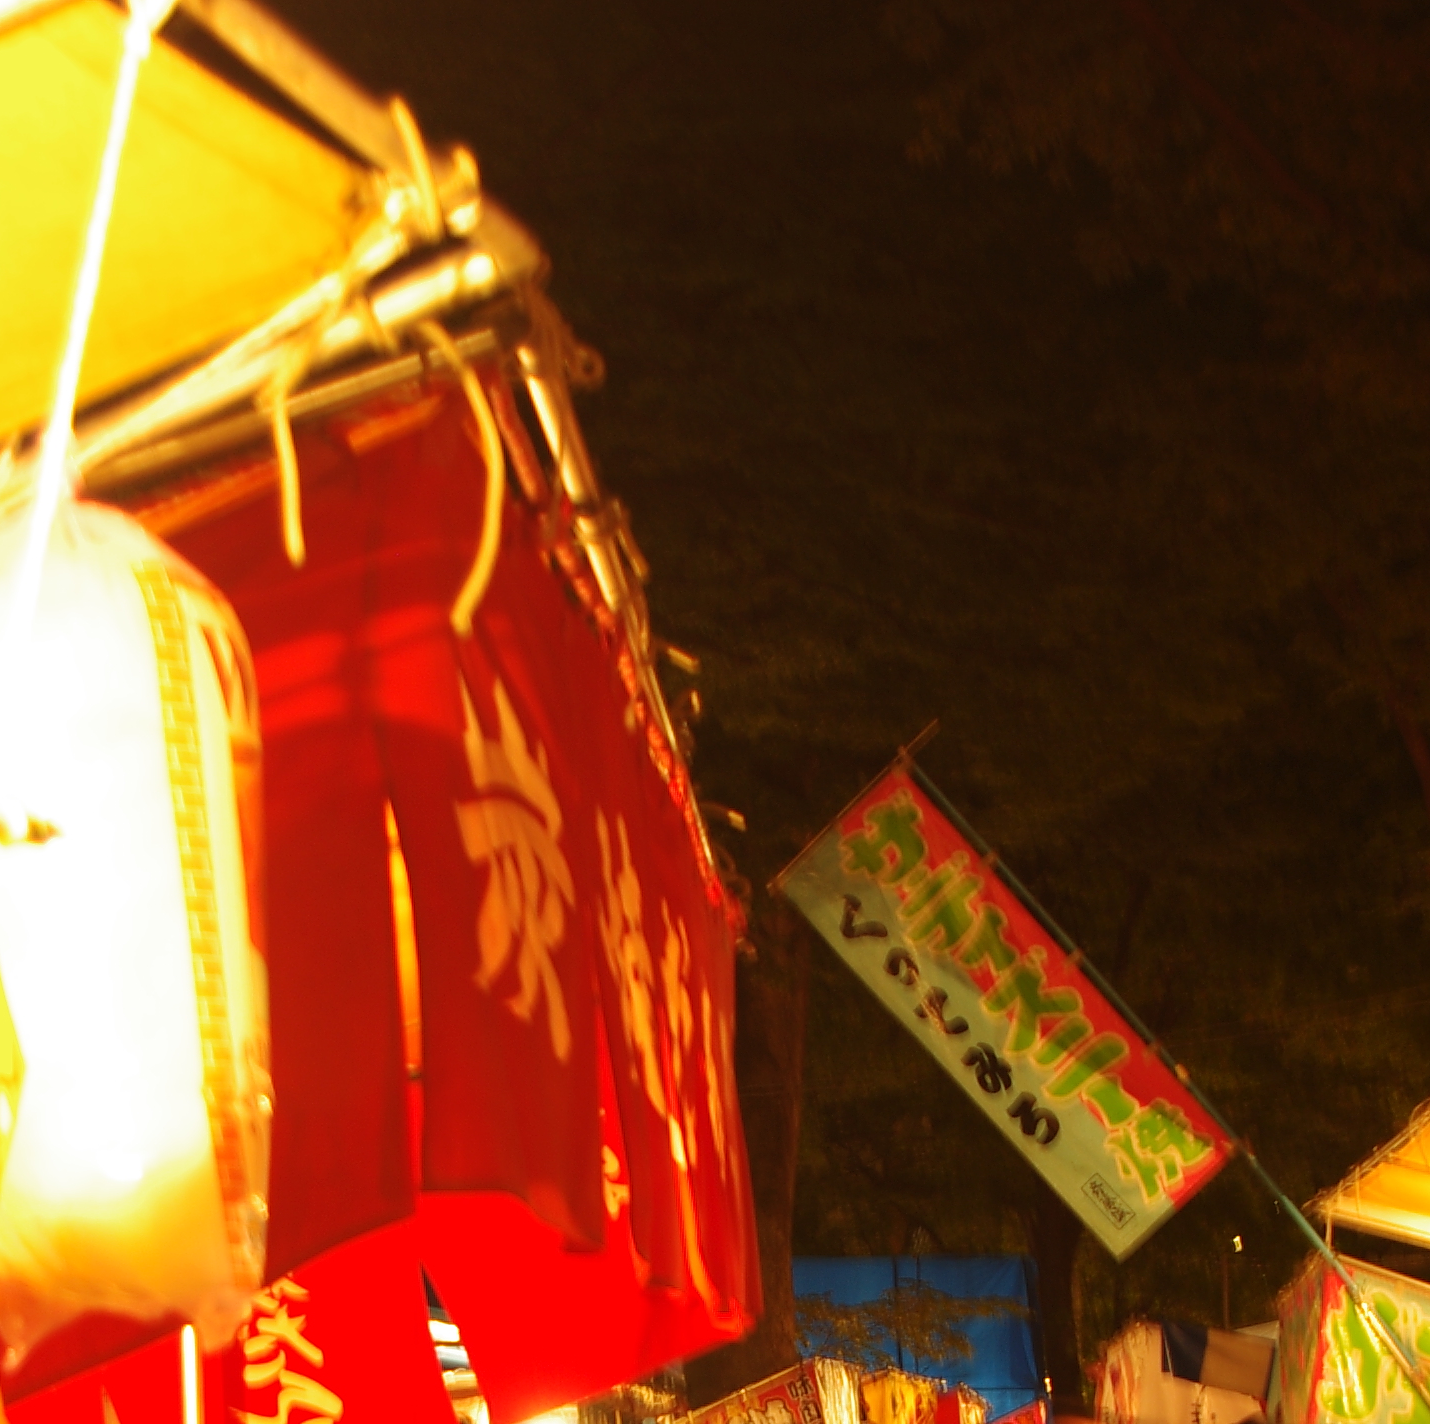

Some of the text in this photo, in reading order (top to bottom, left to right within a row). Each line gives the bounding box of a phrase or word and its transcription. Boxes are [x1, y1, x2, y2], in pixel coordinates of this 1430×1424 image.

[837, 894, 1060, 1147] くってみろ
